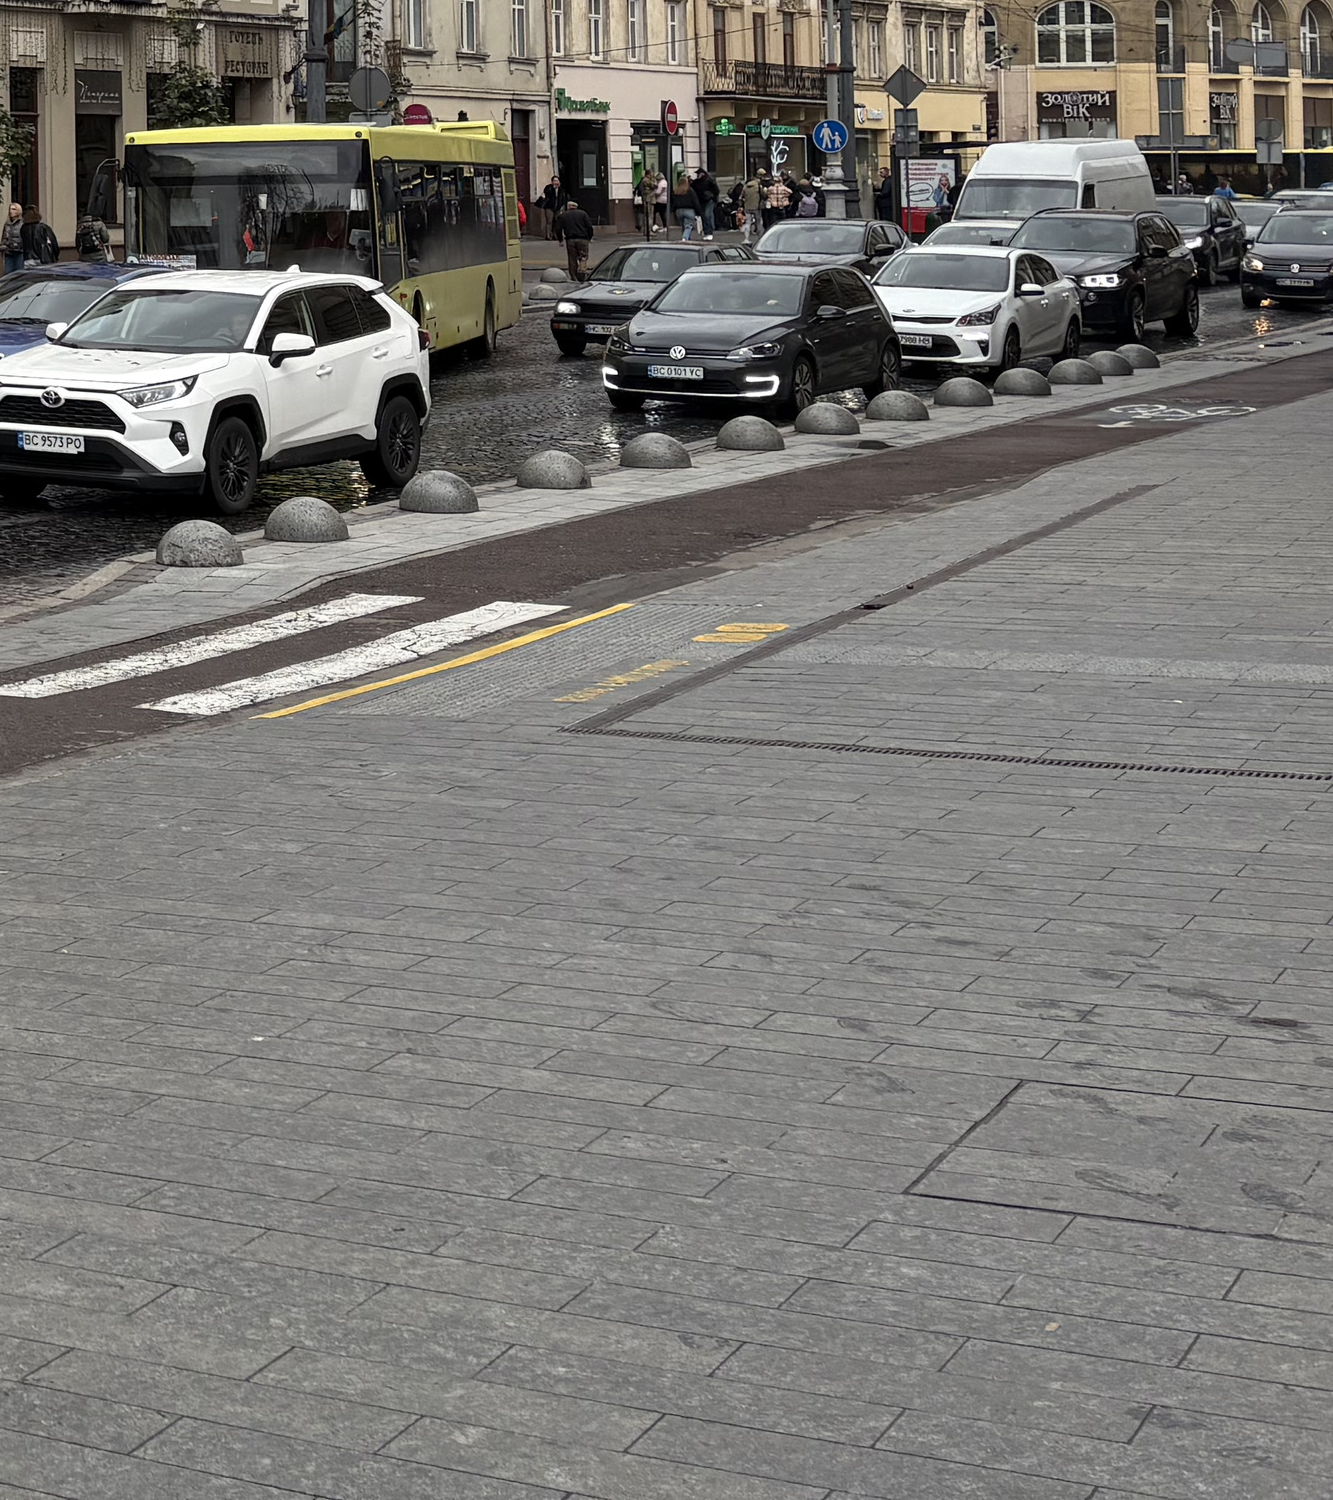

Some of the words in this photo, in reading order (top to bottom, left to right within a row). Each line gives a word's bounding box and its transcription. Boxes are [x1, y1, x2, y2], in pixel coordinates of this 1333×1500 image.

[652, 367, 666, 376] BC
[667, 368, 687, 376] 0101
[24, 434, 39, 446] BC
[41, 435, 64, 448] 9573
[65, 437, 82, 449] PO
